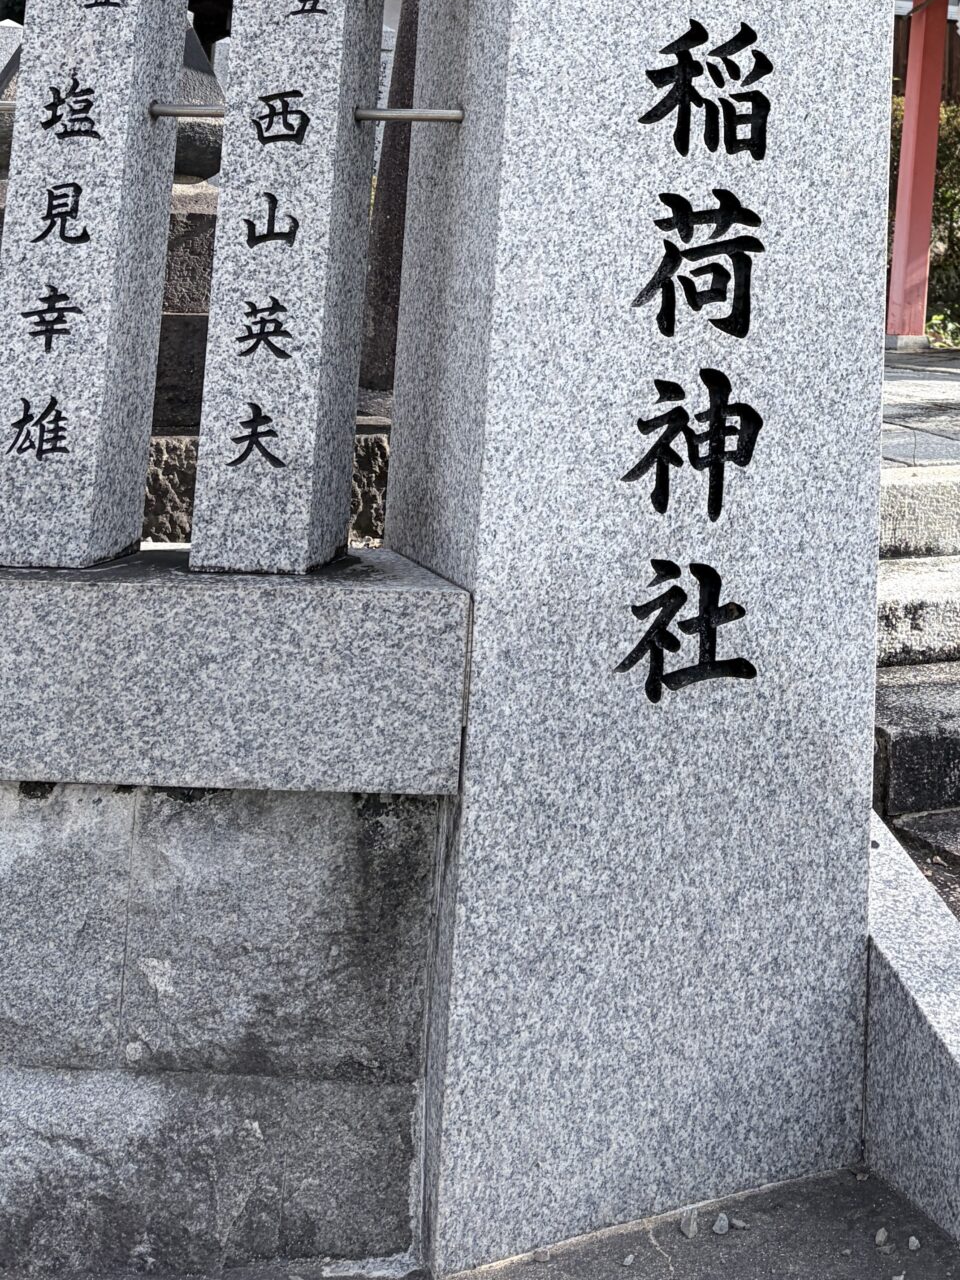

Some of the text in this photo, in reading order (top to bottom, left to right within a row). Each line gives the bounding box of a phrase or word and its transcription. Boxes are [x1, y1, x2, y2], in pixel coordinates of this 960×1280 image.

[6, 77, 101, 462] 塩見幸雄
[226, 89, 312, 469] 西山英夫
